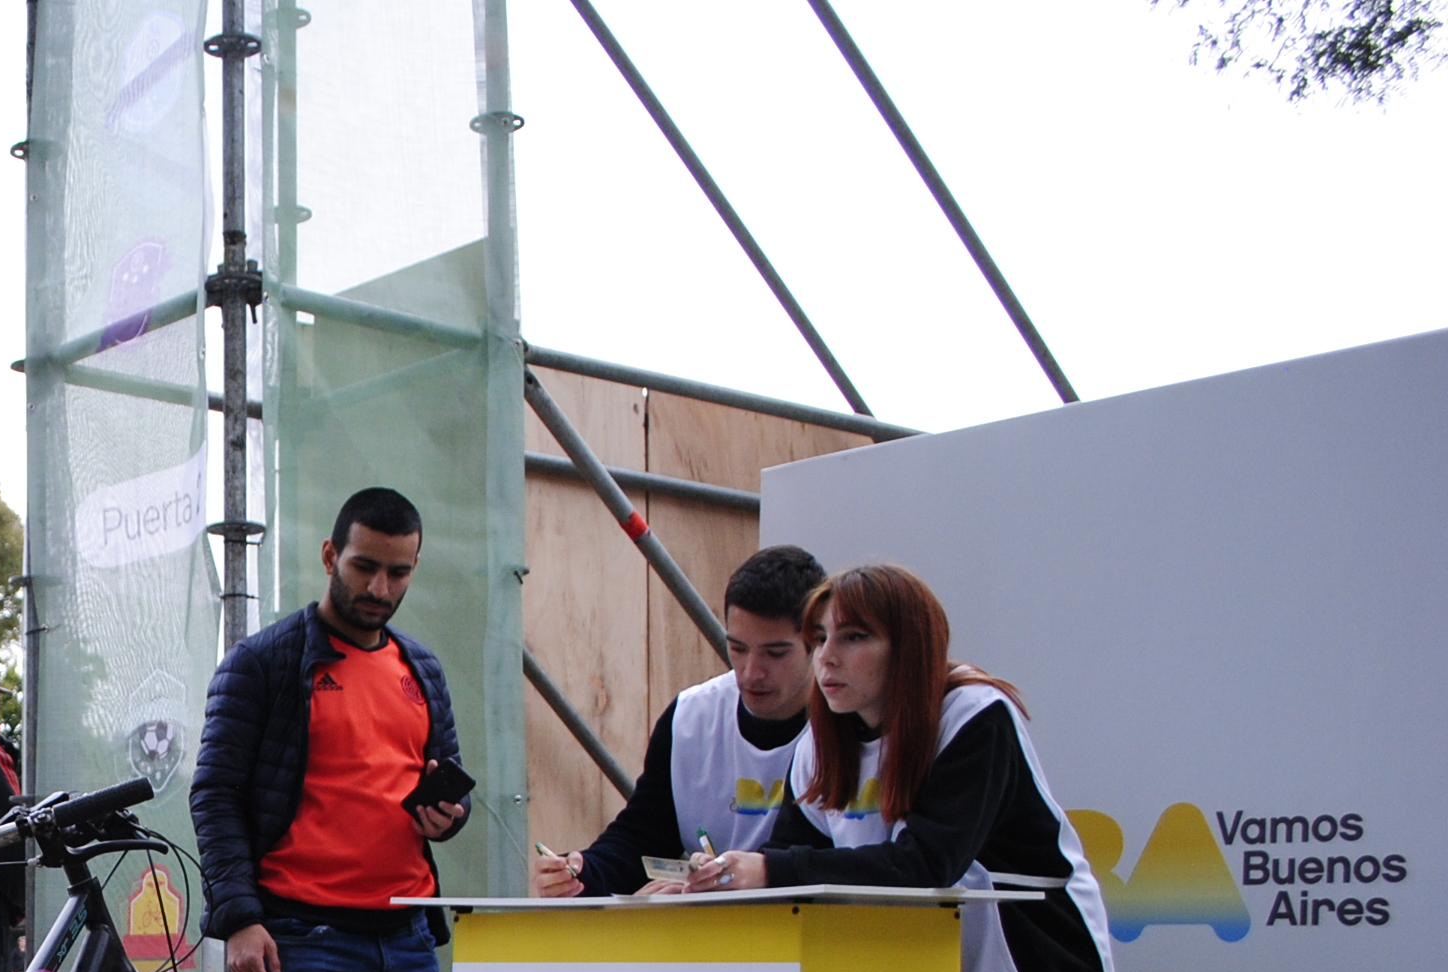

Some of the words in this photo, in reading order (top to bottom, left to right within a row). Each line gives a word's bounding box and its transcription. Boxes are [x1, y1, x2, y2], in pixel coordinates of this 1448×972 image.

[102, 490, 193, 547] Puerta
[1216, 810, 1364, 846] Vamos
[1242, 850, 1407, 886] Buenos
[1265, 890, 1391, 926] Aires
